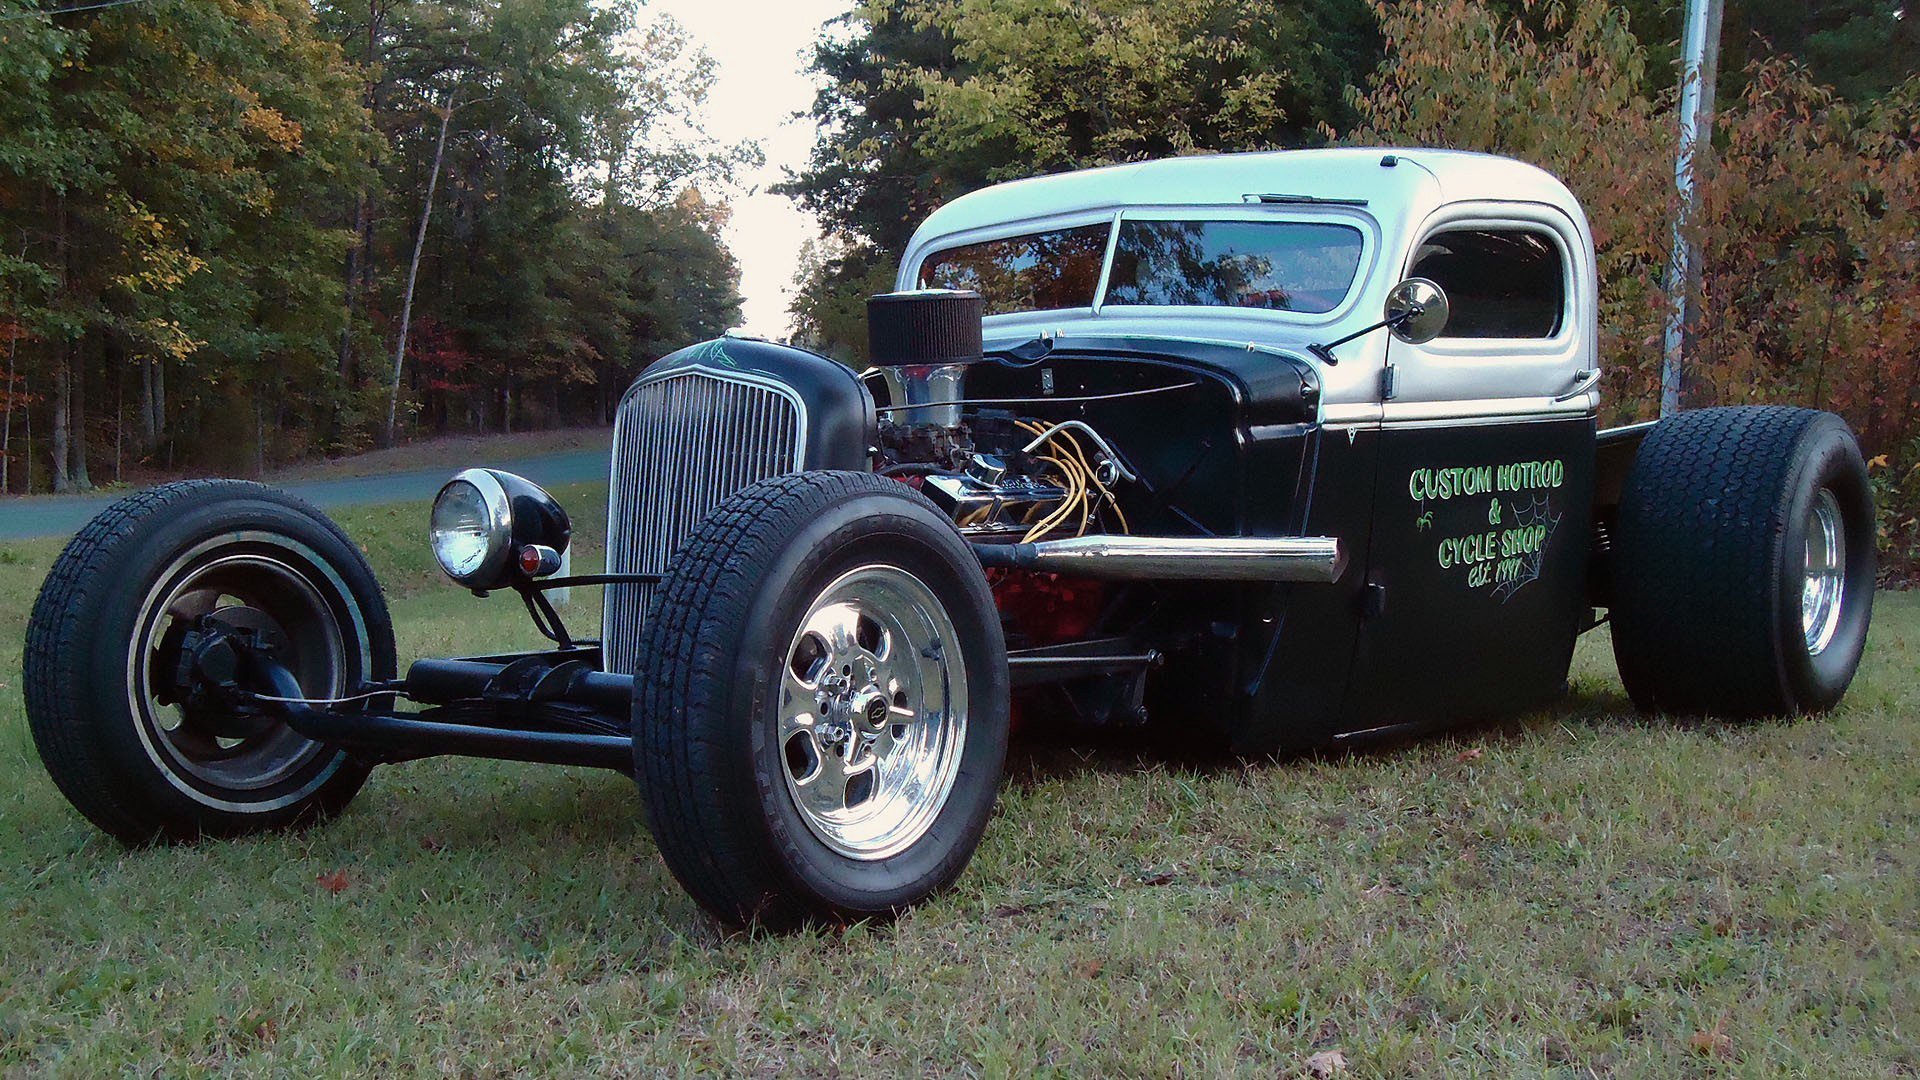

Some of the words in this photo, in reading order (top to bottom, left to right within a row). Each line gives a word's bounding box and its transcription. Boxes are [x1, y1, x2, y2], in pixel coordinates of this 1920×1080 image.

[1409, 465, 1492, 501] CUSTOM
[1497, 459, 1564, 492] HOTROD
[1488, 497, 1502, 525] &
[1438, 531, 1497, 569] CYCLE
[1501, 525, 1547, 558] SHOP
